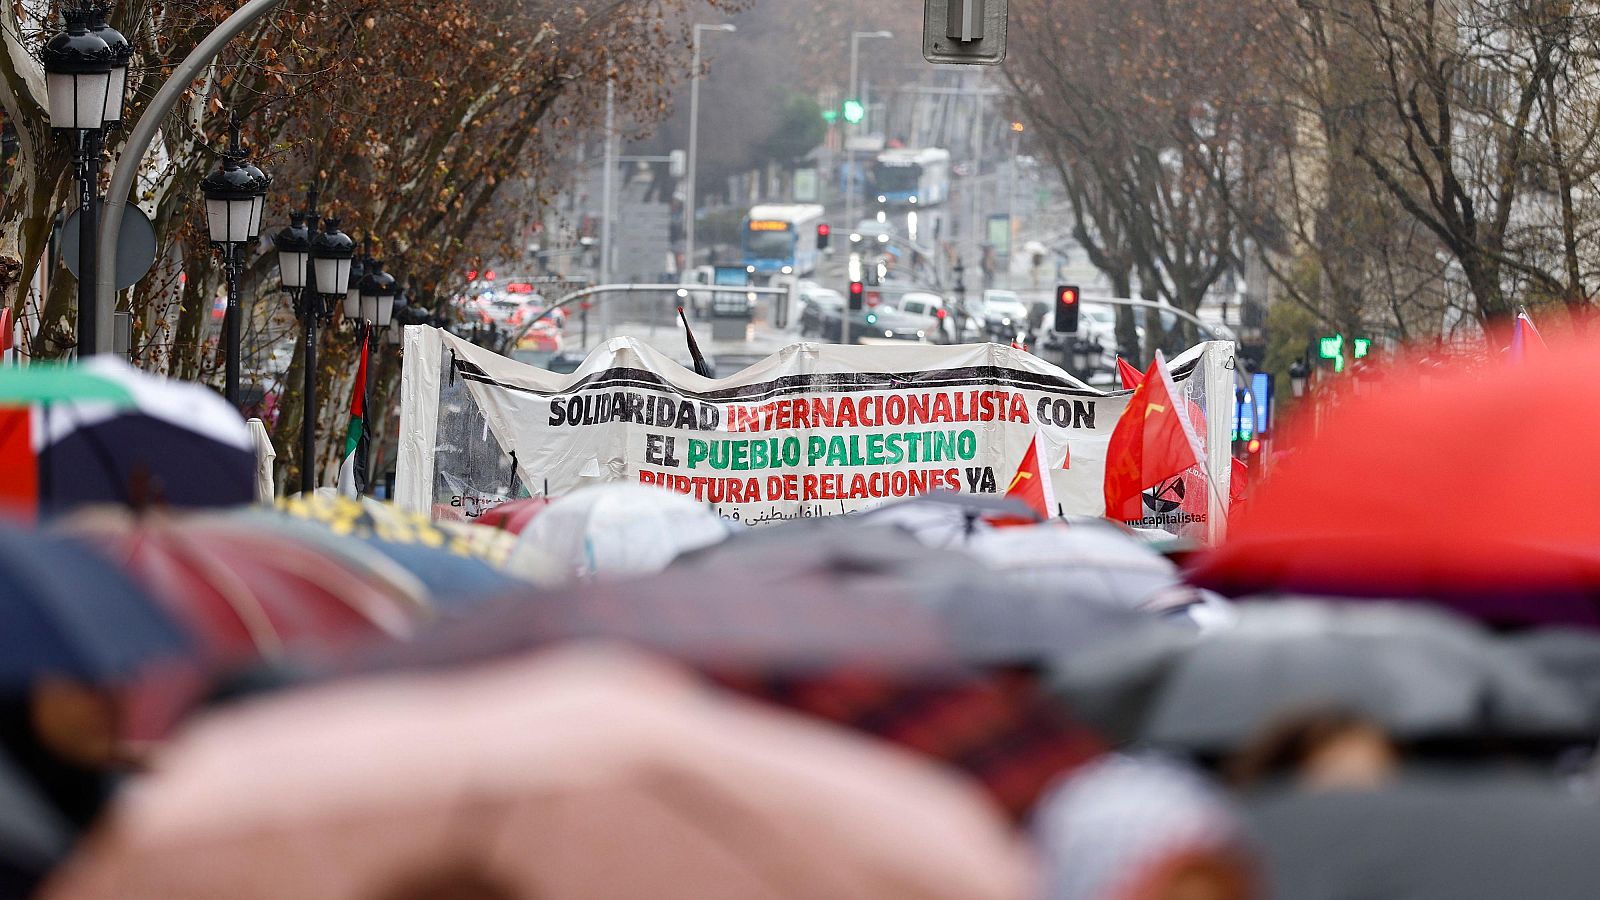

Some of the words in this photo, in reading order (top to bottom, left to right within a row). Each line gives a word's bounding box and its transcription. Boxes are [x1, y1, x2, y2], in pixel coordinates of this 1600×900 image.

[549, 392, 720, 431] SOLIDARIDAD
[726, 391, 1030, 432] INTERNACIONALISTA
[1036, 397, 1096, 429] CON
[645, 433, 680, 468] EL
[687, 436, 801, 471] PUEBLO
[807, 429, 977, 467] PALESTINO
[639, 470, 762, 504] RUPTURA
[767, 474, 799, 502] DE
[803, 467, 961, 501] RELACIONES
[966, 466, 996, 494] YA
